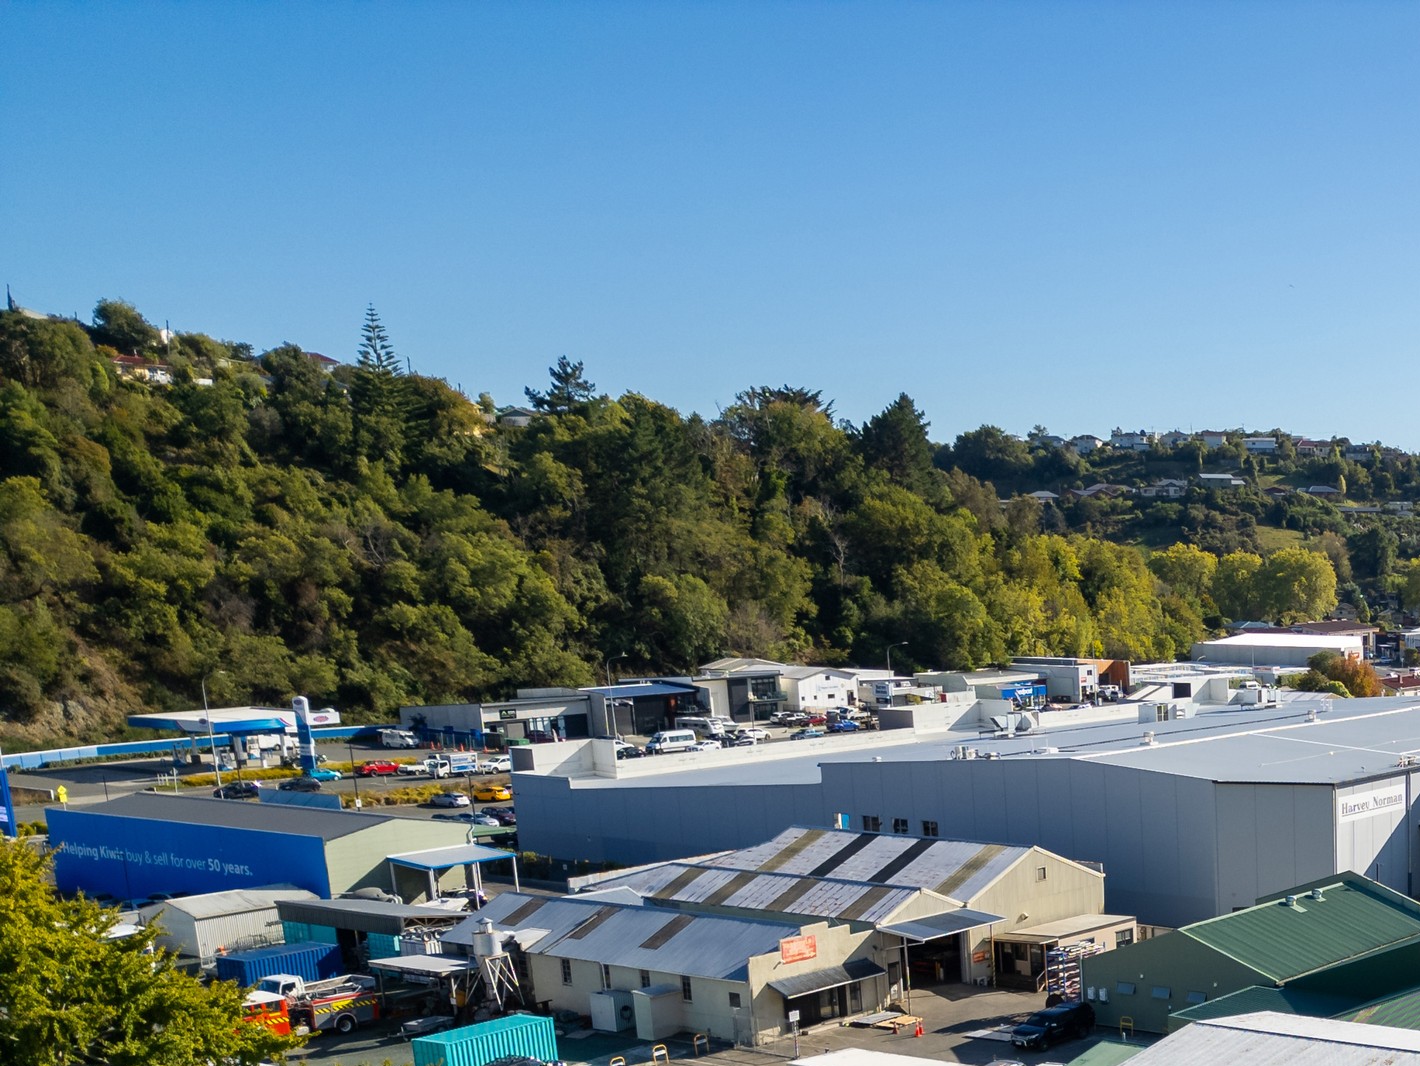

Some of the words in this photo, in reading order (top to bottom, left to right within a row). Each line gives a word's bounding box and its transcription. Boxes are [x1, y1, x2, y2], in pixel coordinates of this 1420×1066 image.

[1341, 800, 1370, 815] Harvey
[1373, 794, 1402, 807] Norman
[62, 841, 99, 861] Helping
[125, 848, 143, 866] buy
[144, 851, 152, 864] &
[153, 853, 169, 867] sell
[170, 854, 184, 868] for
[186, 859, 206, 871] over
[208, 858, 221, 872] 50
[222, 862, 253, 876] years.
